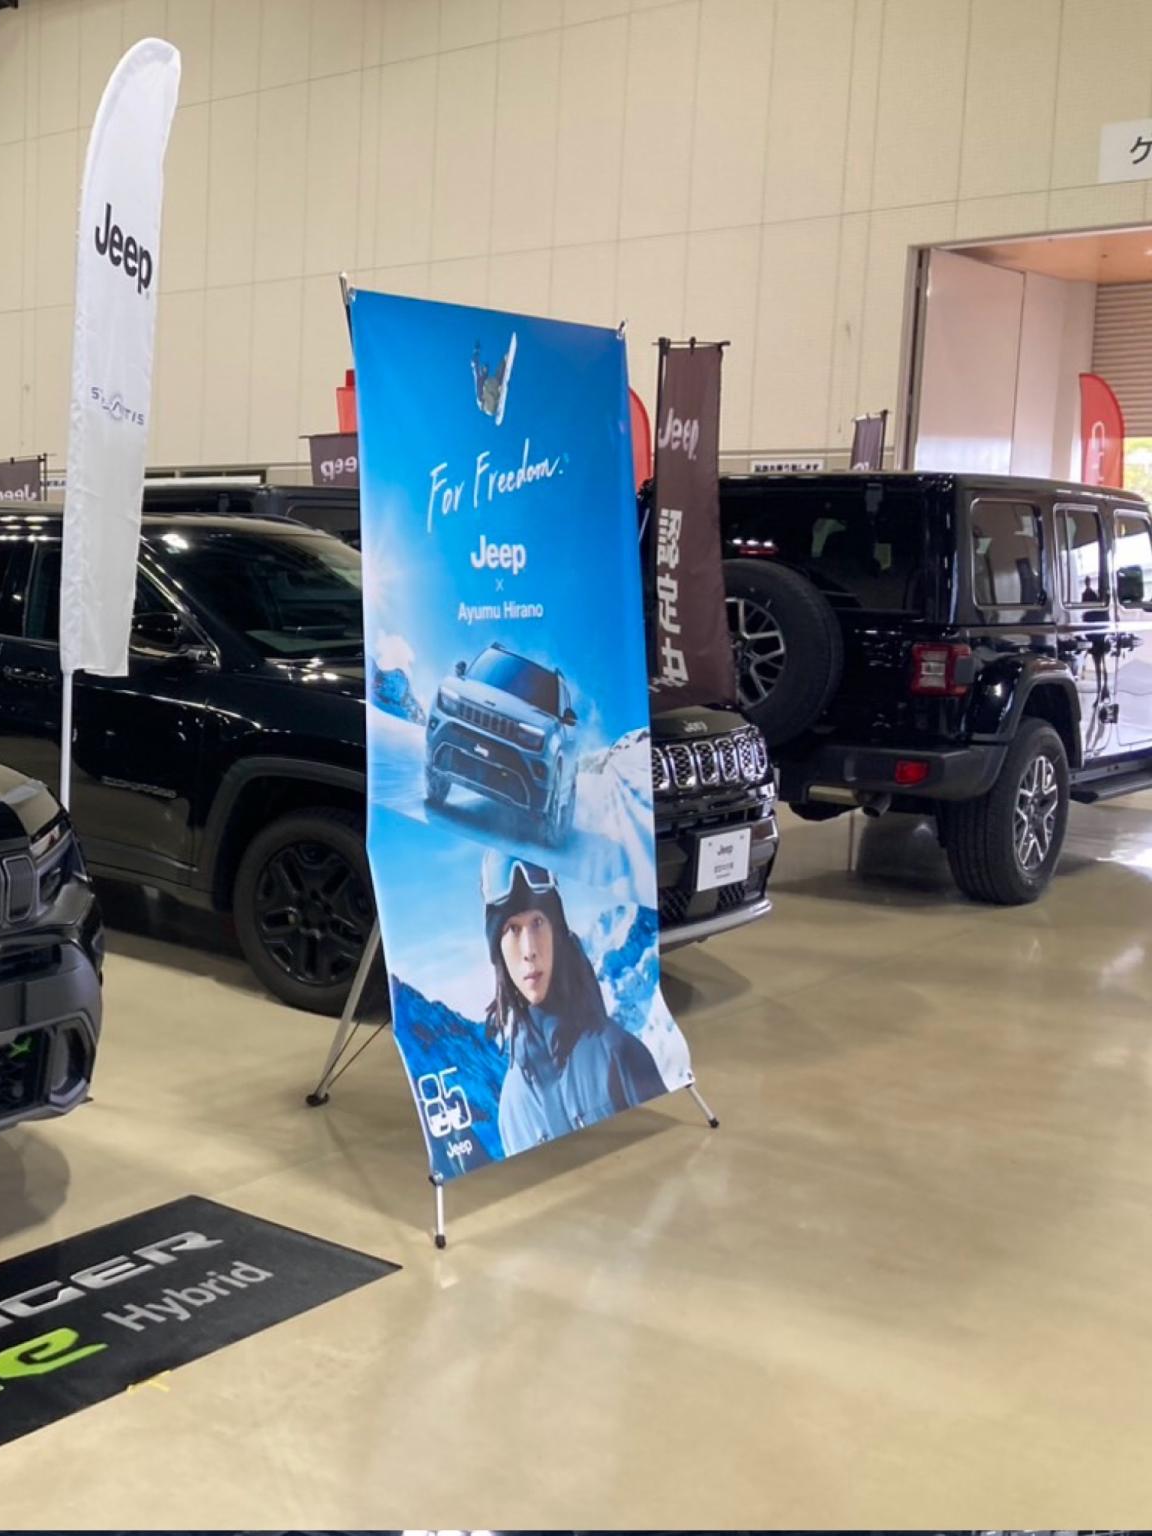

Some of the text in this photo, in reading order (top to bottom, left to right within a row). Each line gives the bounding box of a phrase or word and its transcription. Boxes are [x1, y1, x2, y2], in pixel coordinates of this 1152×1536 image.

[94, 203, 153, 295] Jeep
[658, 408, 699, 459] Jeep
[427, 462, 465, 533] For
[470, 534, 527, 576] Jeep
[457, 600, 544, 626] Ayumu Hirano
[102, 1260, 274, 1333] Hybrid
